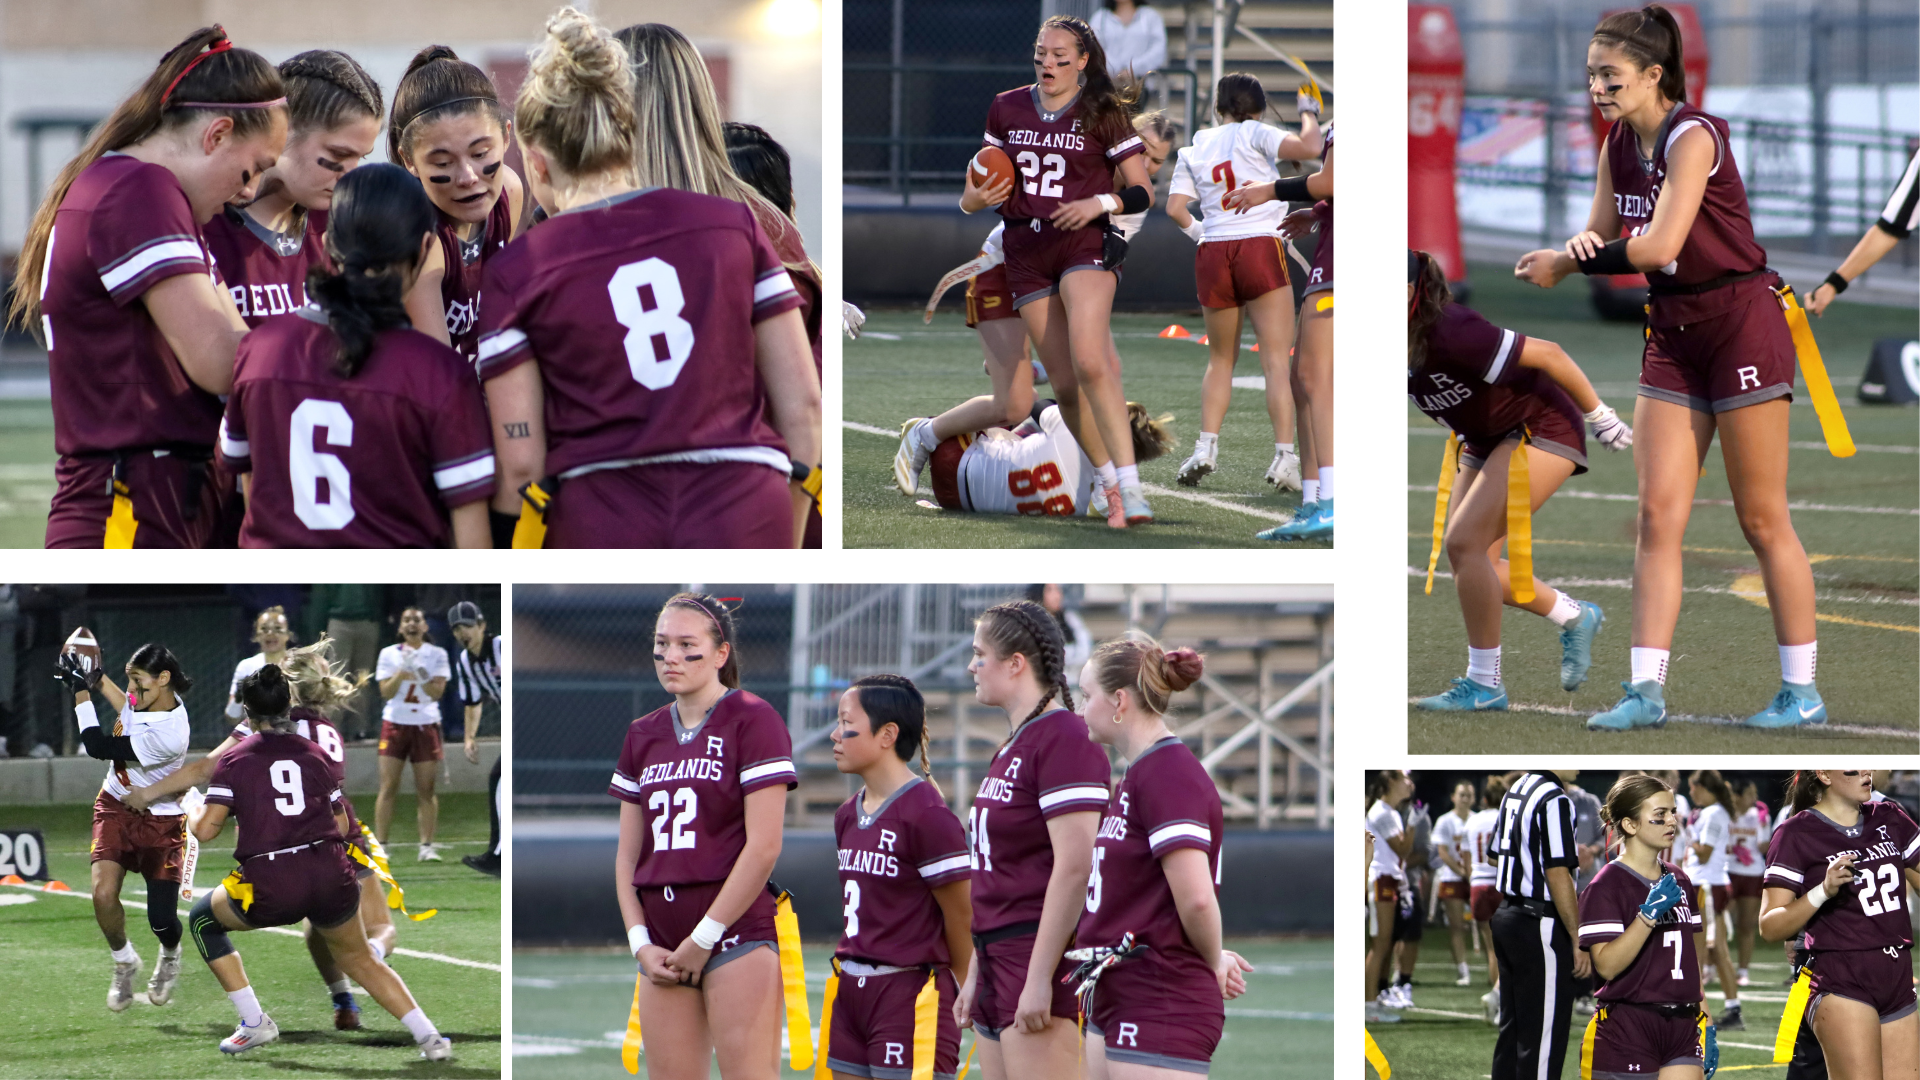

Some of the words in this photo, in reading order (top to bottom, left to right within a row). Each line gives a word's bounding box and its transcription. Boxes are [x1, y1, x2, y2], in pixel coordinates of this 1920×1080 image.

[1008, 129, 1085, 151] REDLANDS
[1016, 150, 1066, 198] 22
[1311, 267, 1323, 283] R
[607, 257, 695, 391] 8
[1429, 373, 1454, 389] R
[1737, 365, 1761, 390] R
[502, 421, 530, 439] VII
[289, 398, 356, 530] 6
[706, 735, 724, 757] R
[639, 758, 723, 787] REDLANDS
[1003, 756, 1021, 779] R
[269, 759, 306, 816] 9
[648, 786, 697, 853] 22
[878, 828, 897, 852] R
[968, 806, 992, 872] 24
[1875, 825, 1890, 840] R
[1854, 863, 1901, 917] 22
[843, 880, 861, 939] 3
[1663, 930, 1684, 979] 7
[1117, 1022, 1139, 1046] R
[884, 1042, 904, 1065] R
